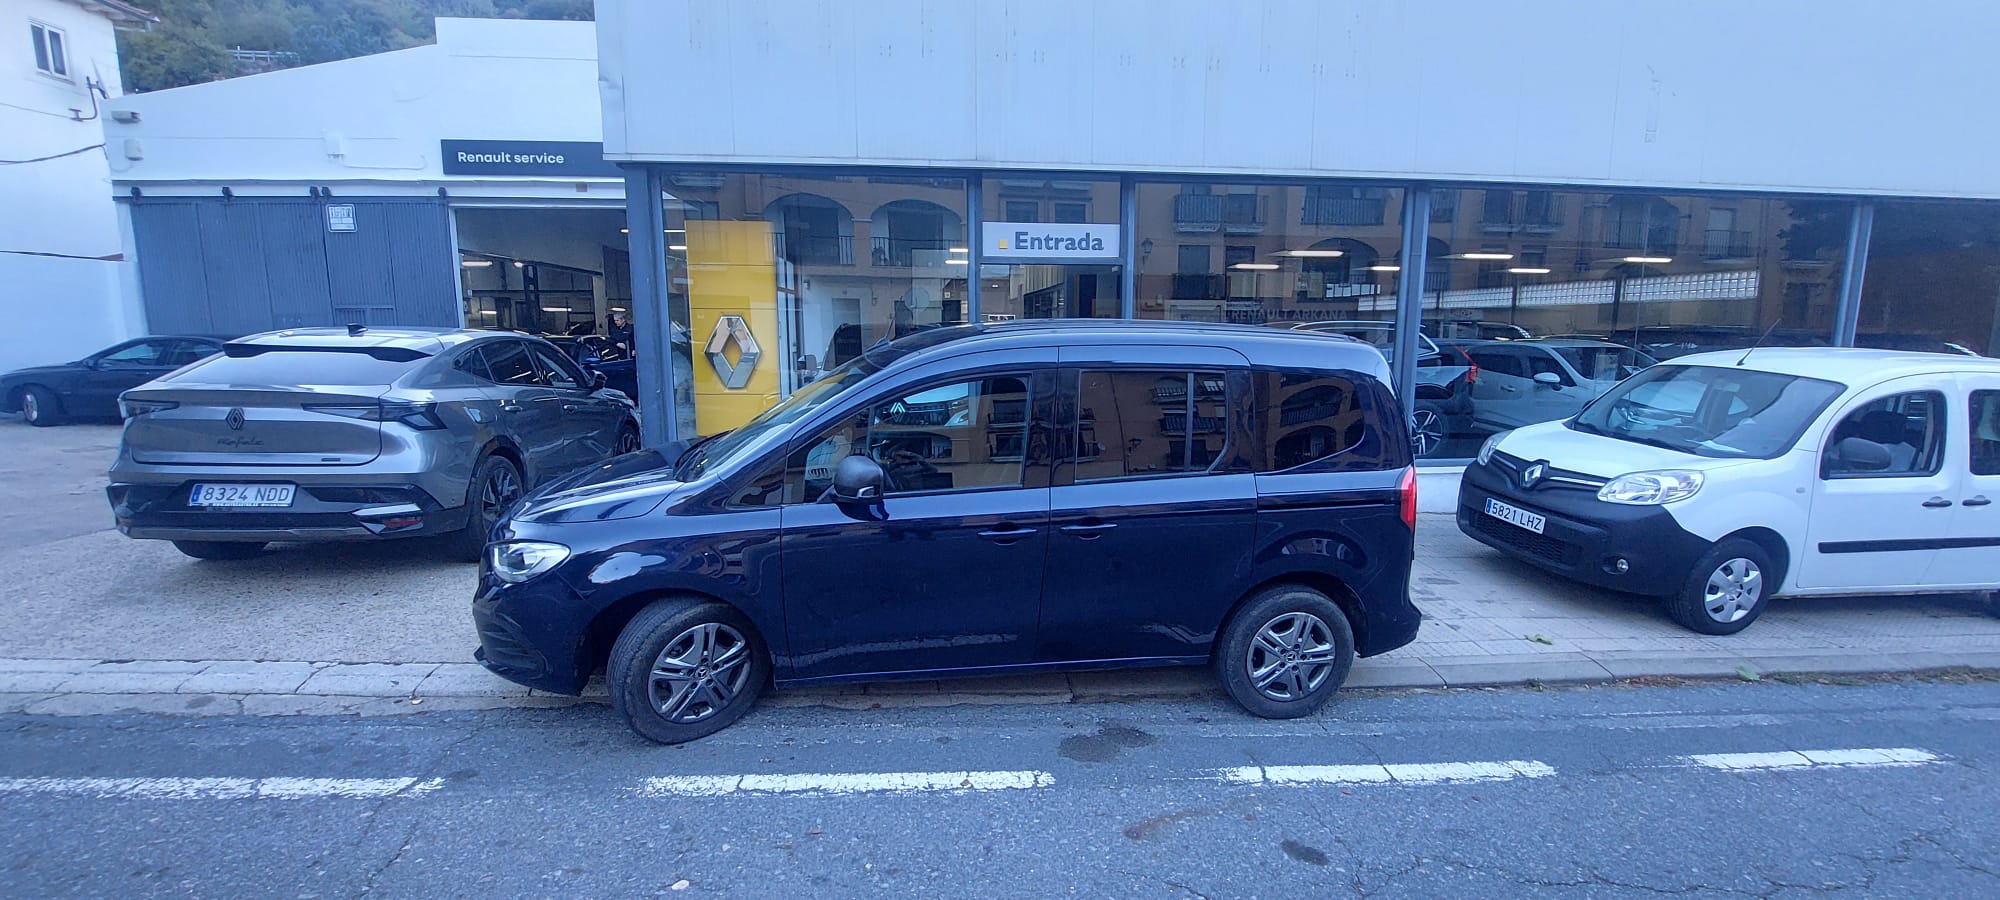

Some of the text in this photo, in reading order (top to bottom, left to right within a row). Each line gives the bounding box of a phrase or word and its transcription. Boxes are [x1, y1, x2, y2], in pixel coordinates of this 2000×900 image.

[457, 151, 565, 164] Renault service
[1014, 231, 1105, 251] Entrada
[1231, 308, 1348, 321] RENAULT ARKANA
[203, 487, 249, 501] 8324
[254, 487, 290, 502] NDD
[1491, 502, 1543, 531] 5821 LHZ
